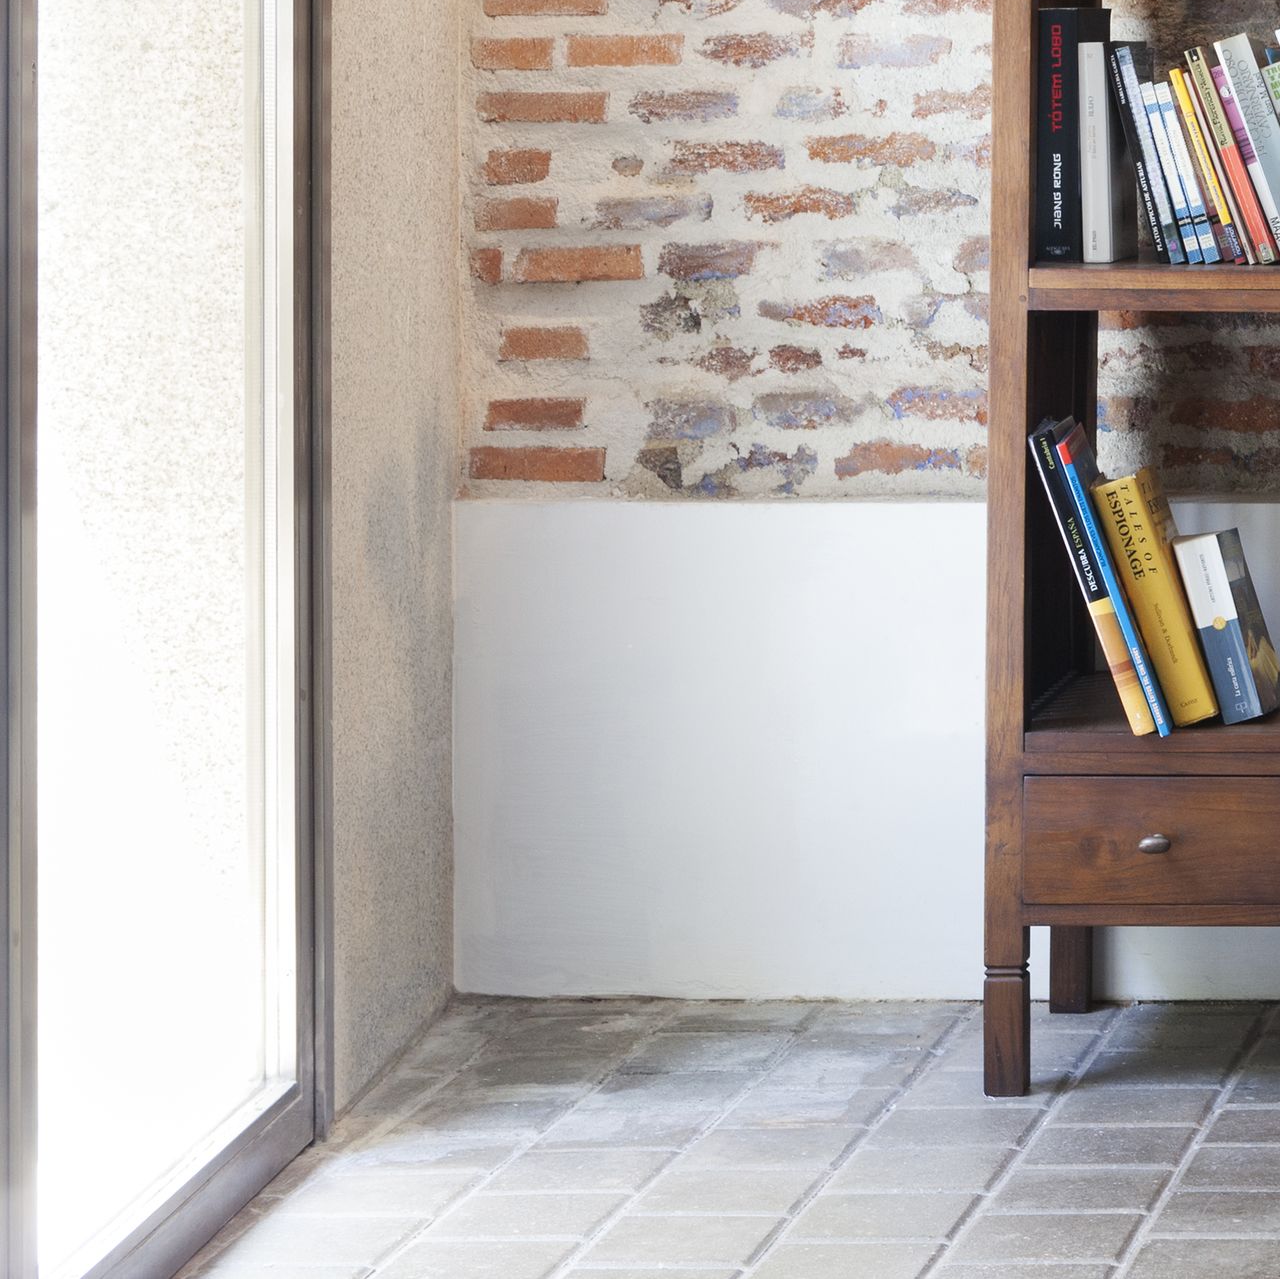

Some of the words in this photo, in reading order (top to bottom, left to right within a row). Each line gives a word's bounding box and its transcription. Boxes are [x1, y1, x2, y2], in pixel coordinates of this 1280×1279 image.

[1050, 24, 1061, 66] LOBO
[1048, 74, 1062, 131] TÓTEM
[1204, 90, 1219, 125] Florencia
[1239, 57, 1270, 140] CAVERNARIO
[1053, 153, 1061, 187] RONG
[1136, 161, 1147, 192] ASTURIAS
[1053, 192, 1061, 228] JIANG
[1143, 191, 1150, 201] DE
[1152, 225, 1162, 251] PLATOS
[1040, 440, 1056, 470] Cantabria
[1064, 515, 1083, 549] ESPAÑA
[1108, 489, 1143, 581] ESPIONAGE
[1120, 483, 1145, 545] TALES
[1143, 551, 1157, 576] OF
[1077, 547, 1097, 591] DESCUBRA
[1233, 688, 1241, 696] La
